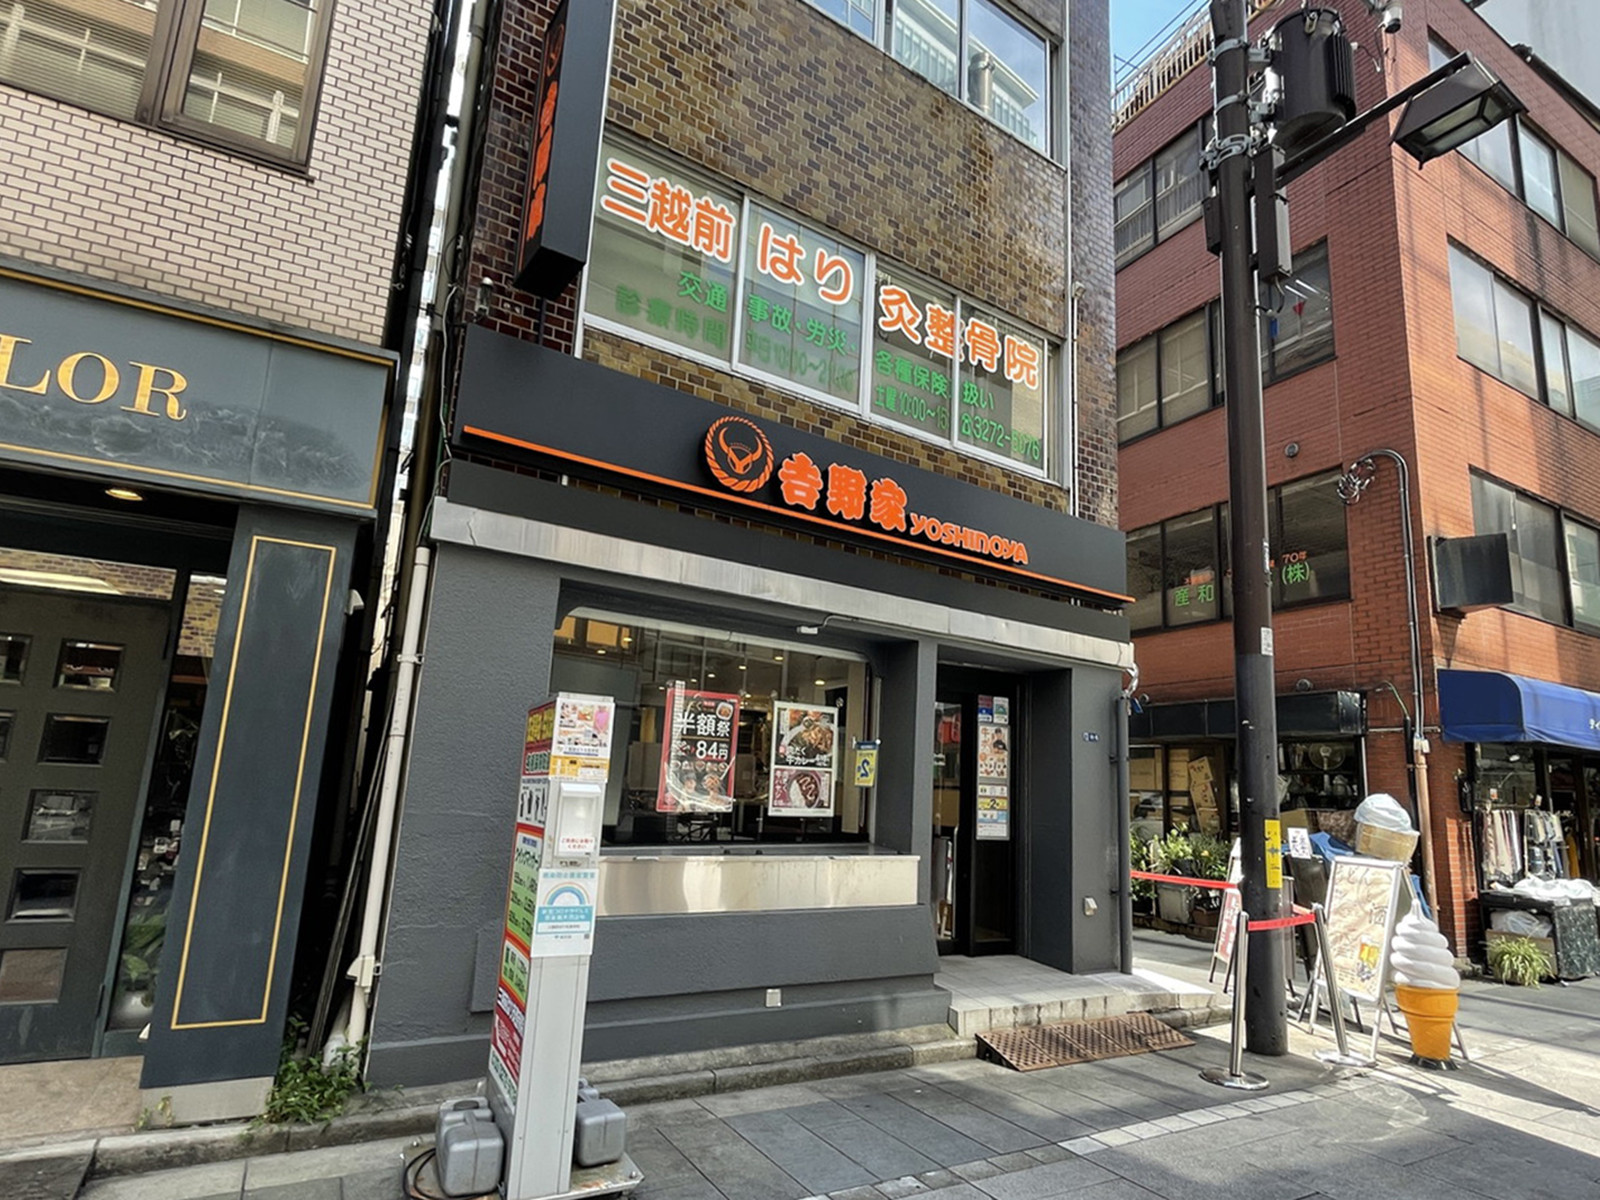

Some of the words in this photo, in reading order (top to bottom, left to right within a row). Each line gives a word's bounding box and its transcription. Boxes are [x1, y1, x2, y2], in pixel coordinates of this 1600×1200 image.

[601, 158, 736, 264] 三越前
[757, 222, 855, 304] はり
[678, 270, 727, 313] 交通
[0, 333, 188, 421] LOR
[909, 512, 1029, 564] YOSHINOYA
